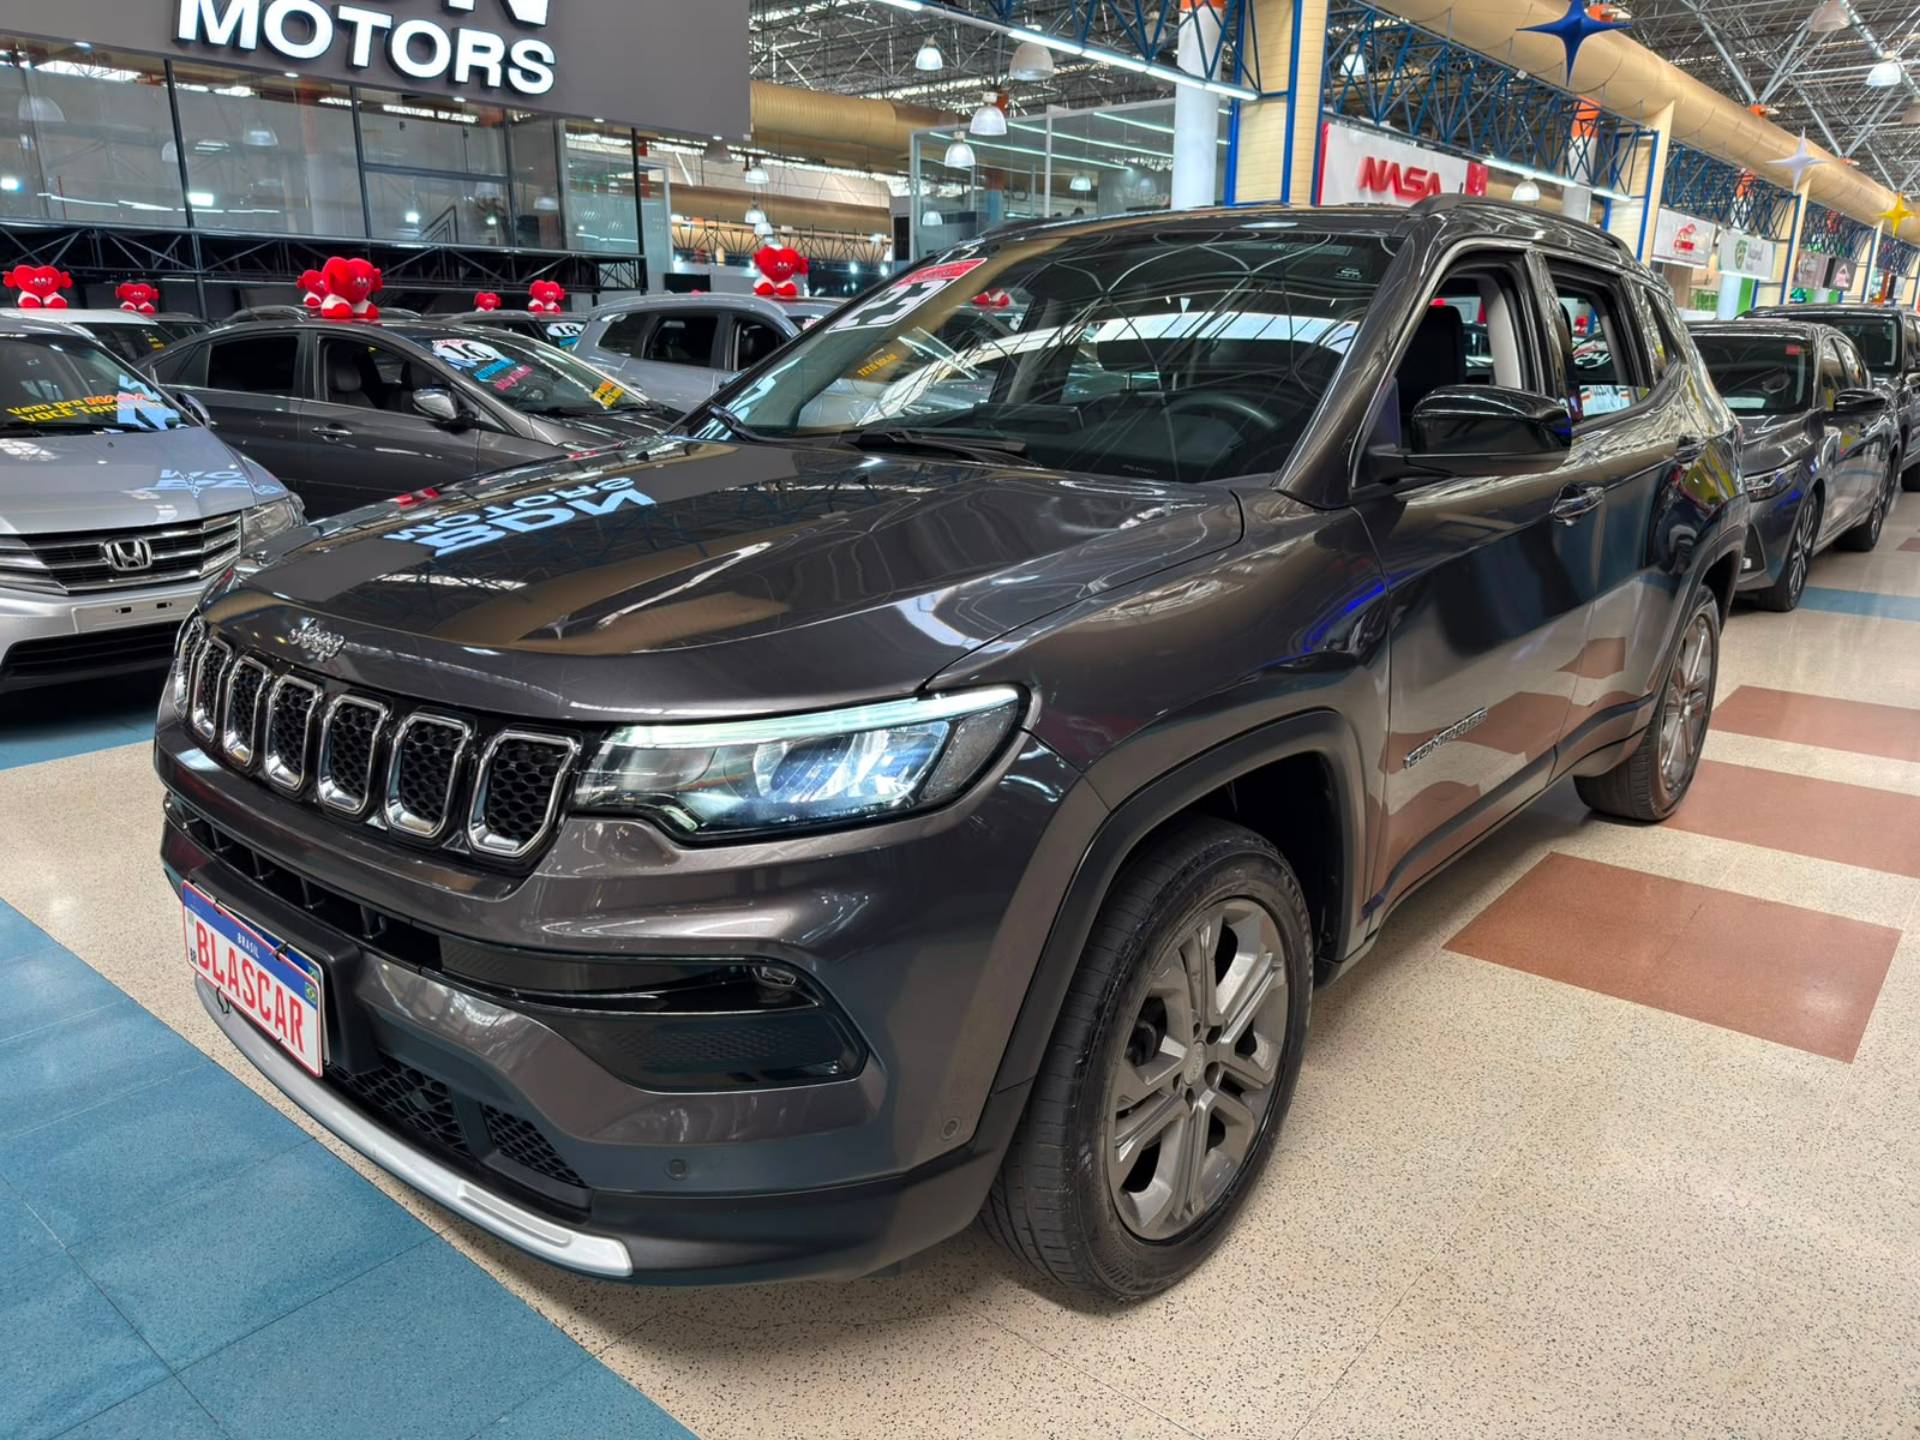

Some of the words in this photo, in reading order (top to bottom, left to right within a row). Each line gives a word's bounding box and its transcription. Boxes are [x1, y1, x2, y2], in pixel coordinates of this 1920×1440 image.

[176, 0, 557, 95] MOTORS
[1359, 156, 1441, 198] NASA
[833, 279, 948, 330] 23
[288, 623, 345, 662] Jeep
[237, 932, 260, 959] BRASIL
[196, 920, 305, 1054] BLASCAR
